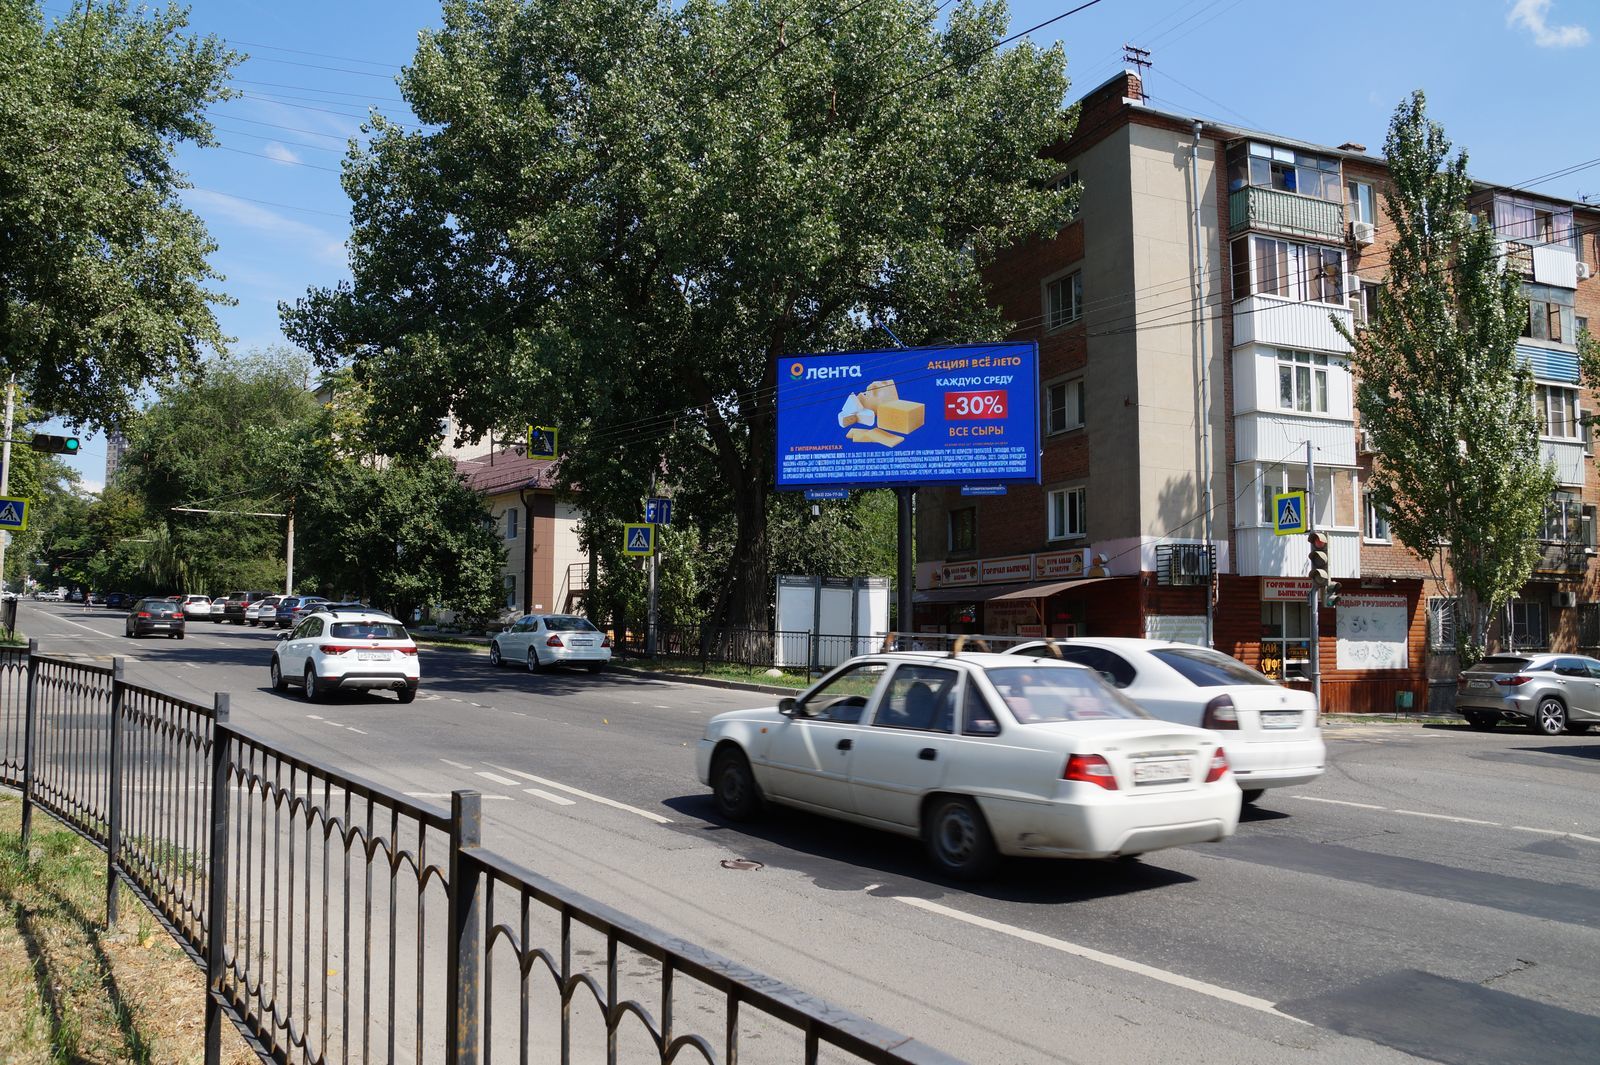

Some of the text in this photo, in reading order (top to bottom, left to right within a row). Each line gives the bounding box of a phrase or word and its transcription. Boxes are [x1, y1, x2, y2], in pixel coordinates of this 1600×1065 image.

[927, 356, 1021, 370] АКЦИЯ! ВСЁ ЛЕТО
[805, 365, 862, 380] лента
[936, 375, 1013, 387] КАЖДУЮ СРЕДУ
[947, 395, 1003, 415] -30%
[949, 426, 1004, 437] ВСЕ СЫРЫ
[795, 444, 843, 452] ГИПЕРМАРКЕТАХ
[983, 565, 1029, 575] ГОРЯЧАЯ ВЫПЕЧКА
